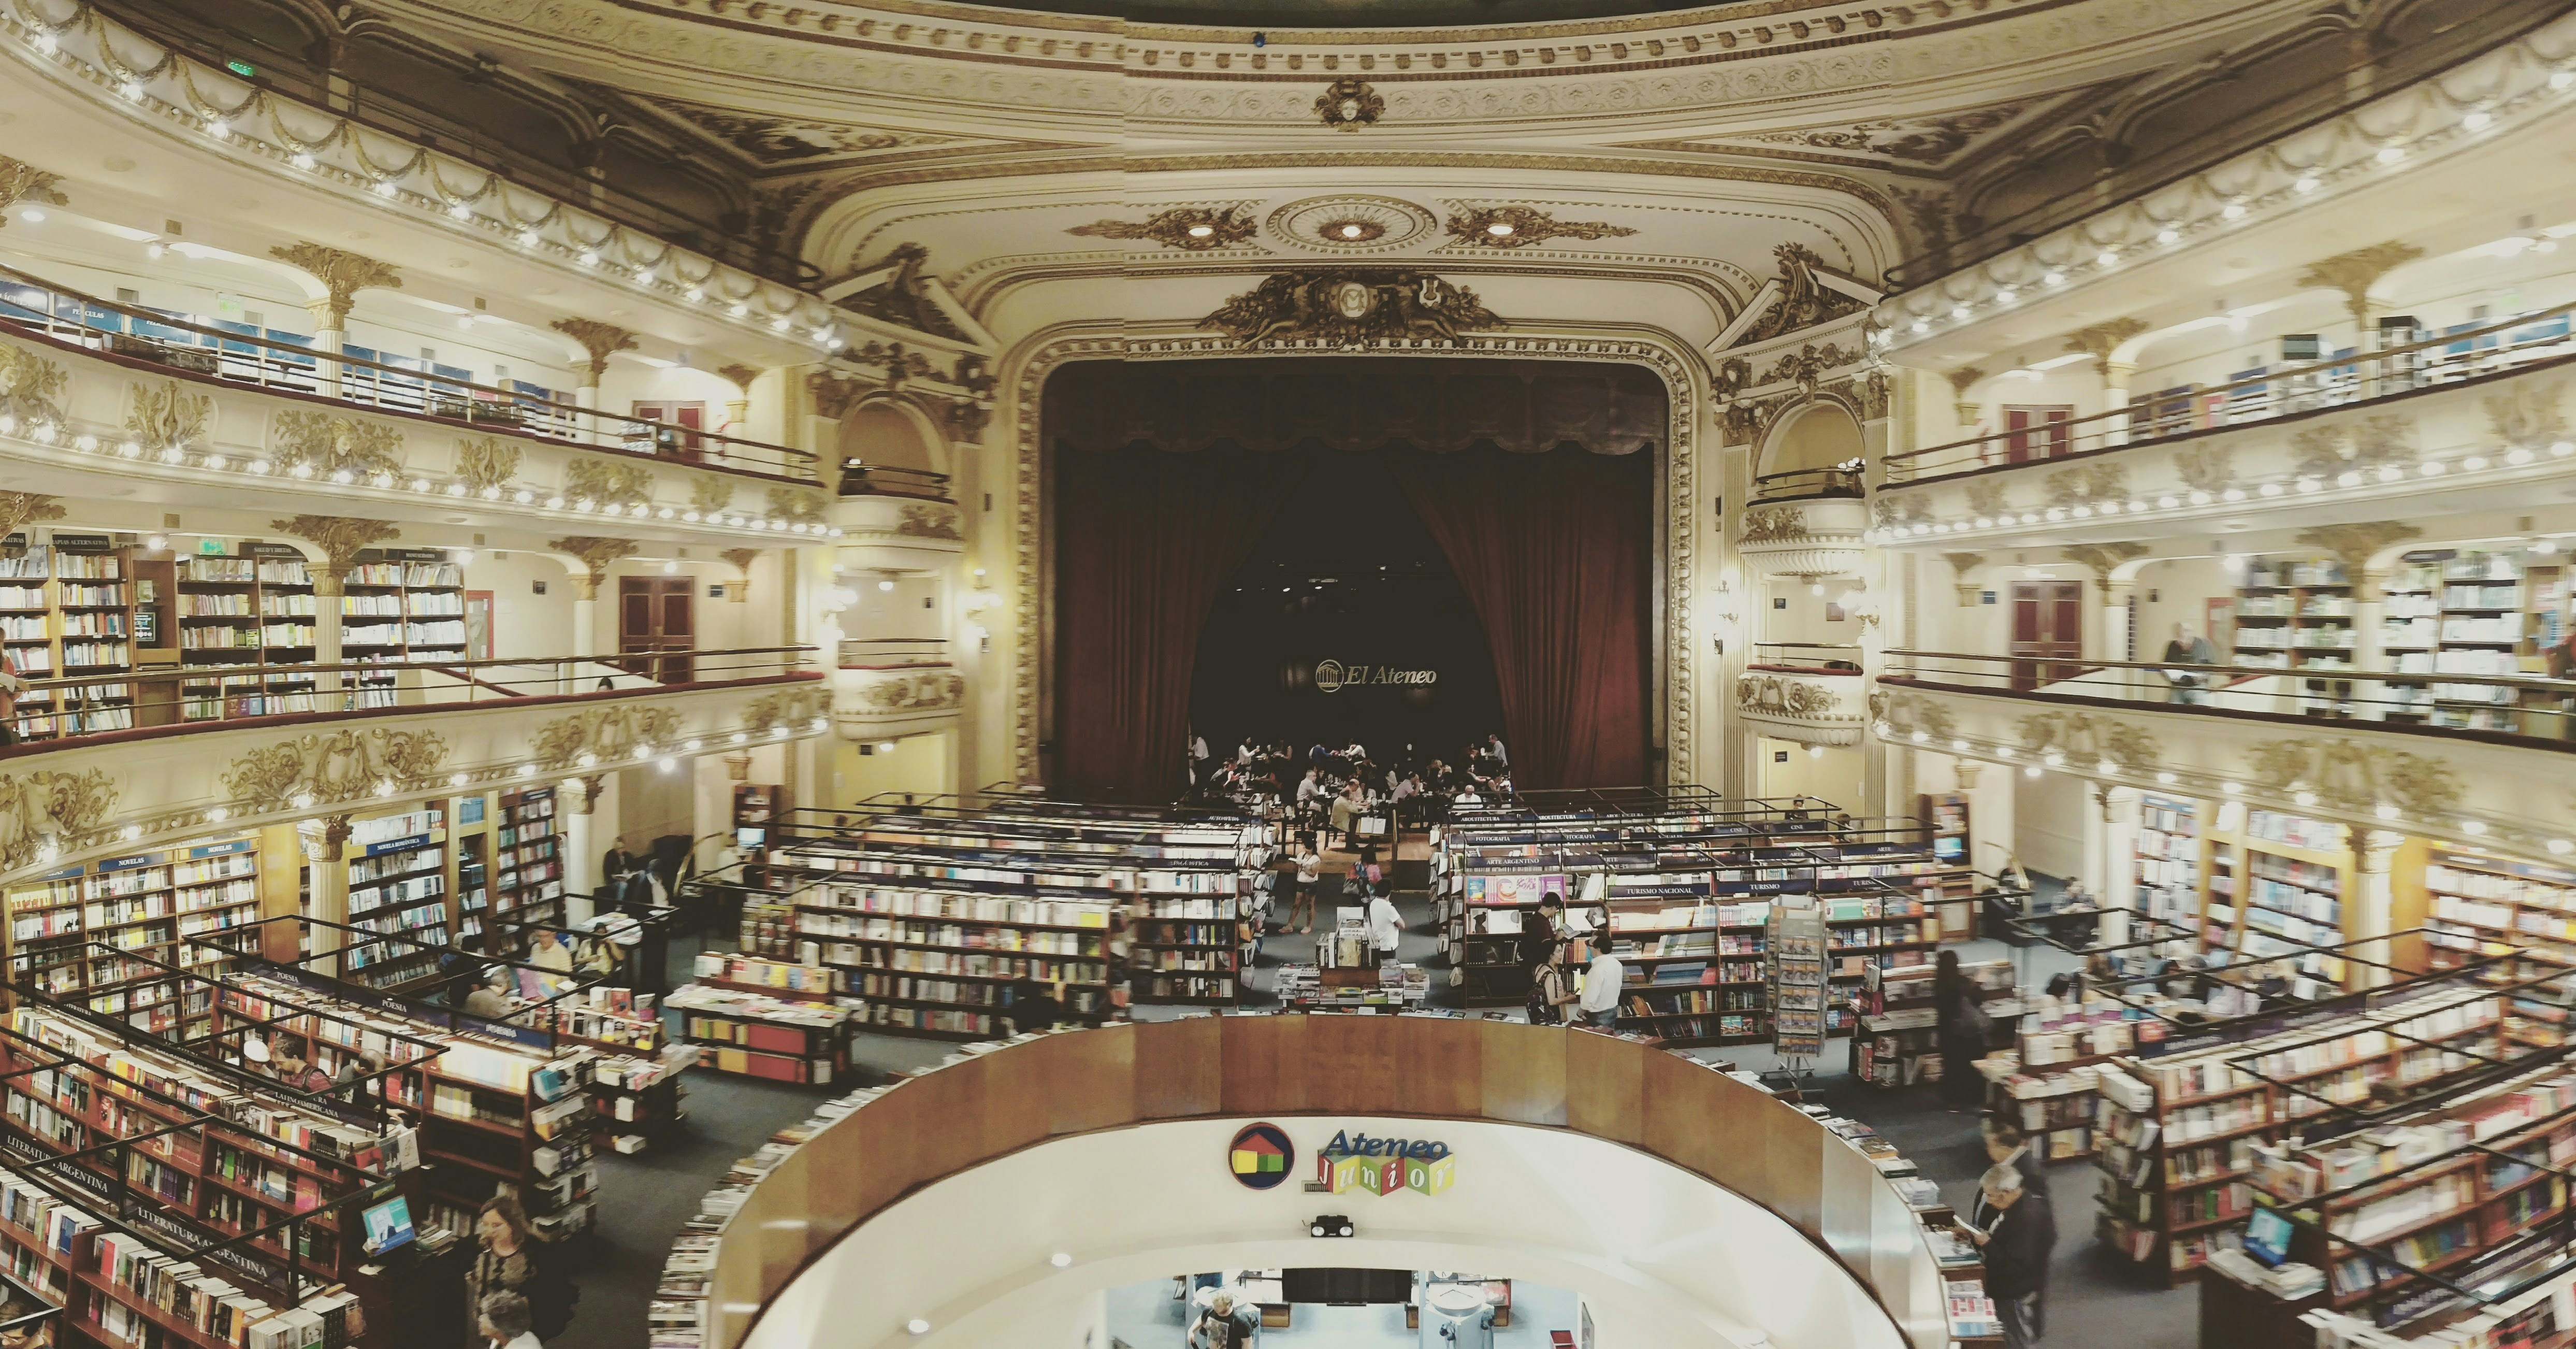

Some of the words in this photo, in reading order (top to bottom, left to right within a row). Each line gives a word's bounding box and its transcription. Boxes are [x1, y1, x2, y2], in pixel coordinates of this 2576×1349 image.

[1344, 666, 1368, 684] El
[1371, 666, 1437, 684] Ateneo
[208, 844, 233, 853] NOVELAS
[119, 857, 145, 866] NOVELAS
[276, 971, 299, 983] POESIA
[382, 999, 407, 1013] POESIA
[275, 1091, 339, 1118] LATINOAMERICANA
[1322, 1129, 1452, 1161] Ateneo
[7, 1135, 55, 1167] LITERATUR
[56, 1161, 108, 1193] ARGENTINA
[1319, 1159, 1452, 1189] Junior
[138, 1206, 201, 1246] LITERATURA
